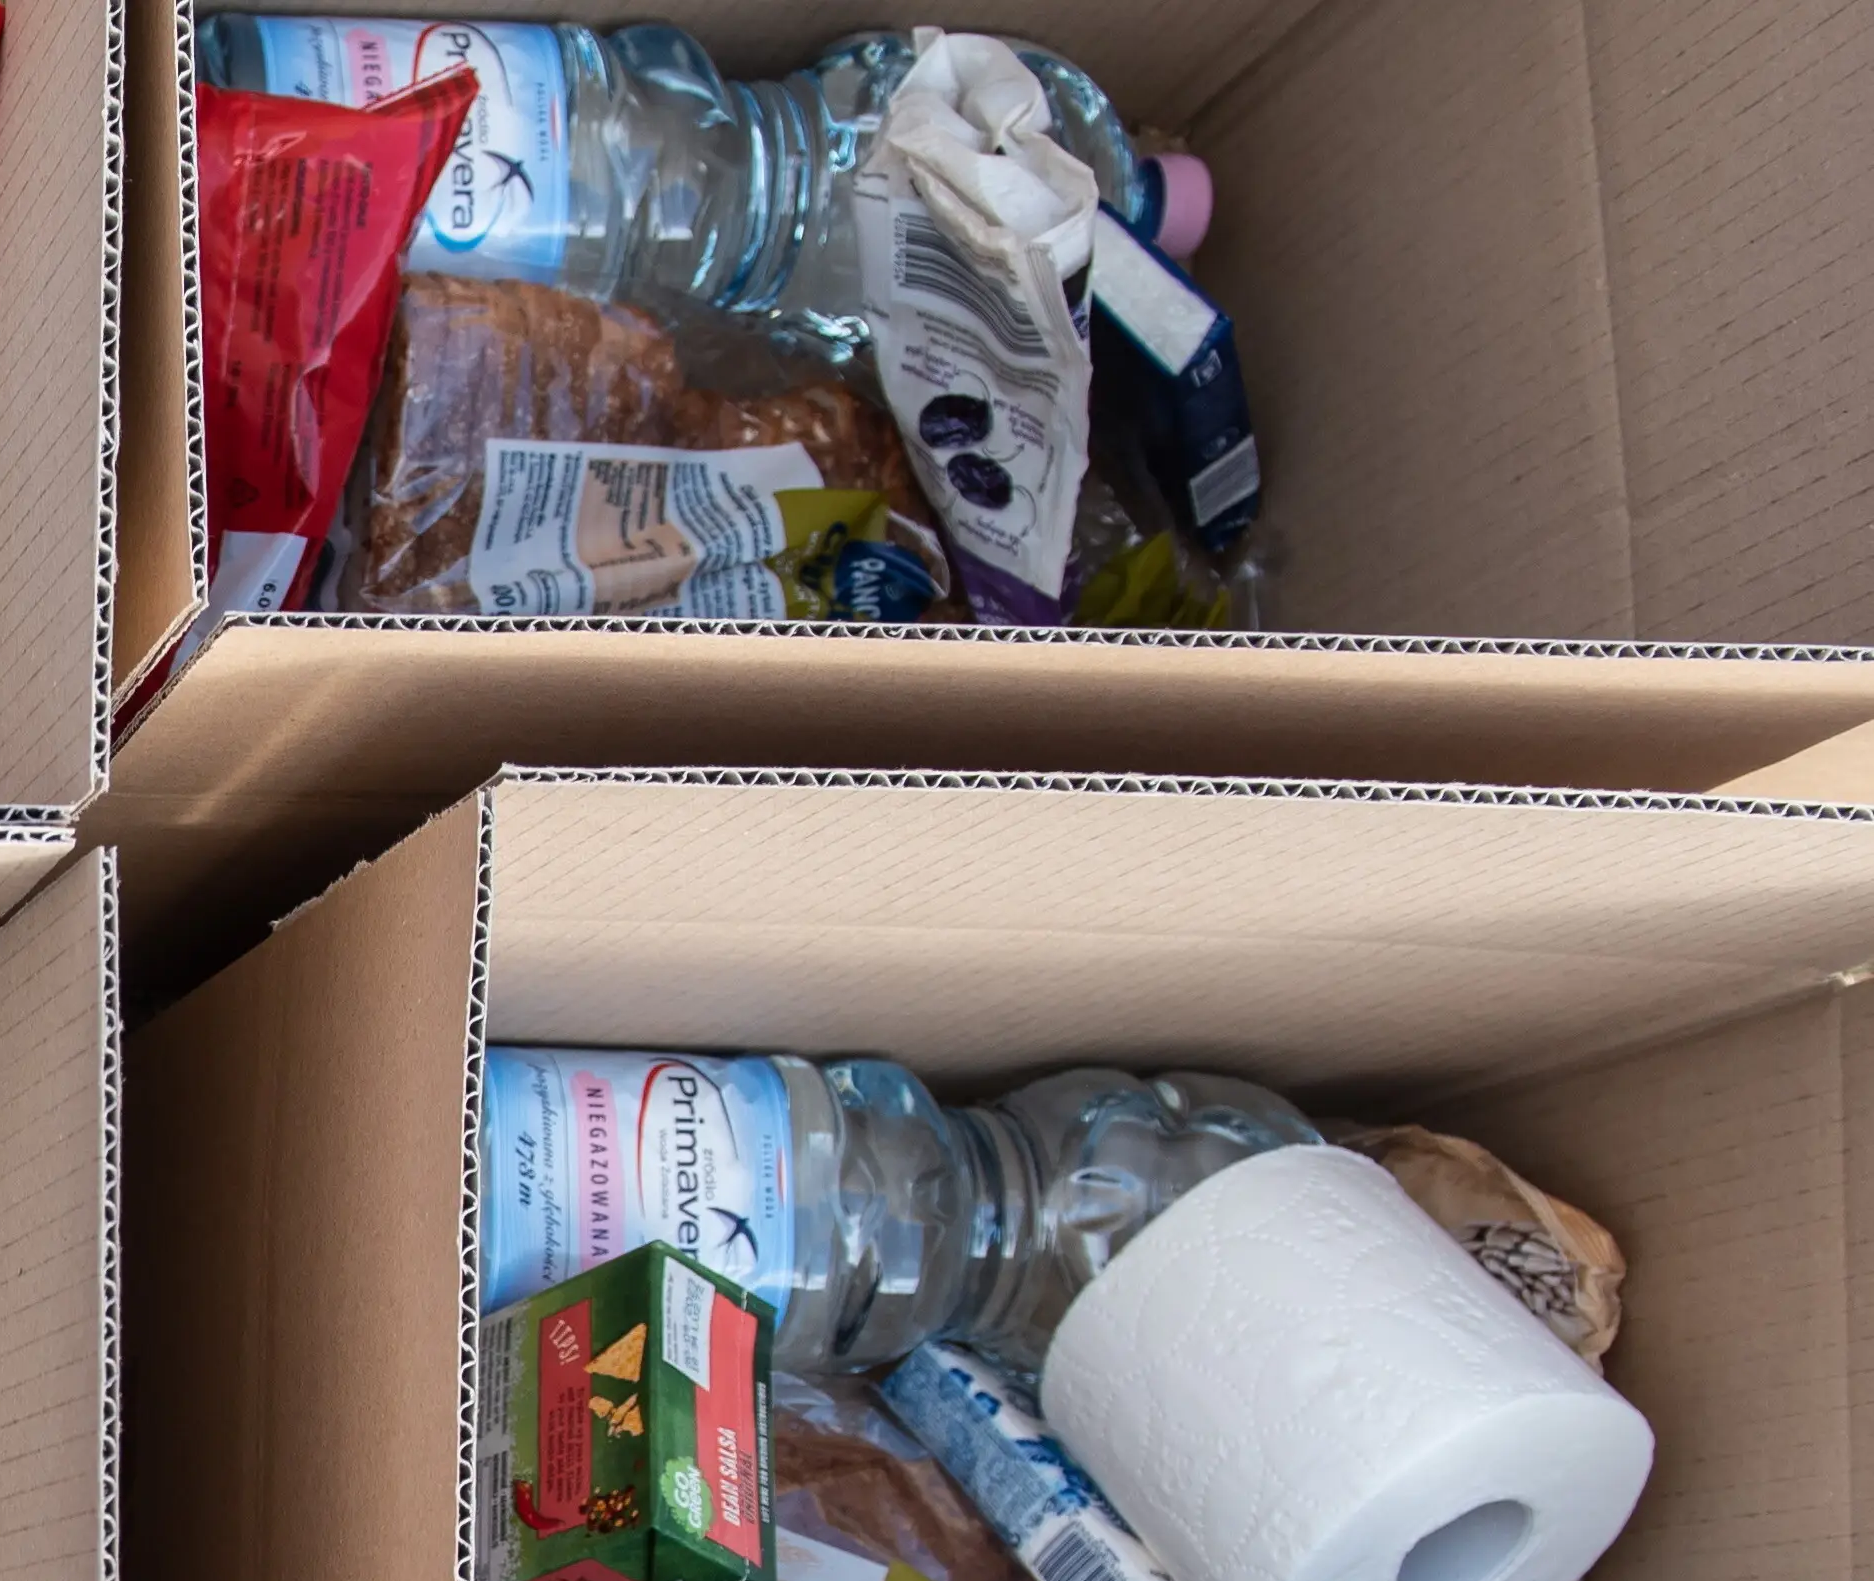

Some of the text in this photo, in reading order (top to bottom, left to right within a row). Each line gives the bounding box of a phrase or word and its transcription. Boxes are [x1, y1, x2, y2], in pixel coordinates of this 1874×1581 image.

[584, 1086, 611, 1259] NIEGAZOWANA
[666, 1075, 702, 1265] Primaver
[672, 1470, 691, 1509] GO
[717, 1426, 739, 1480] SALSA
